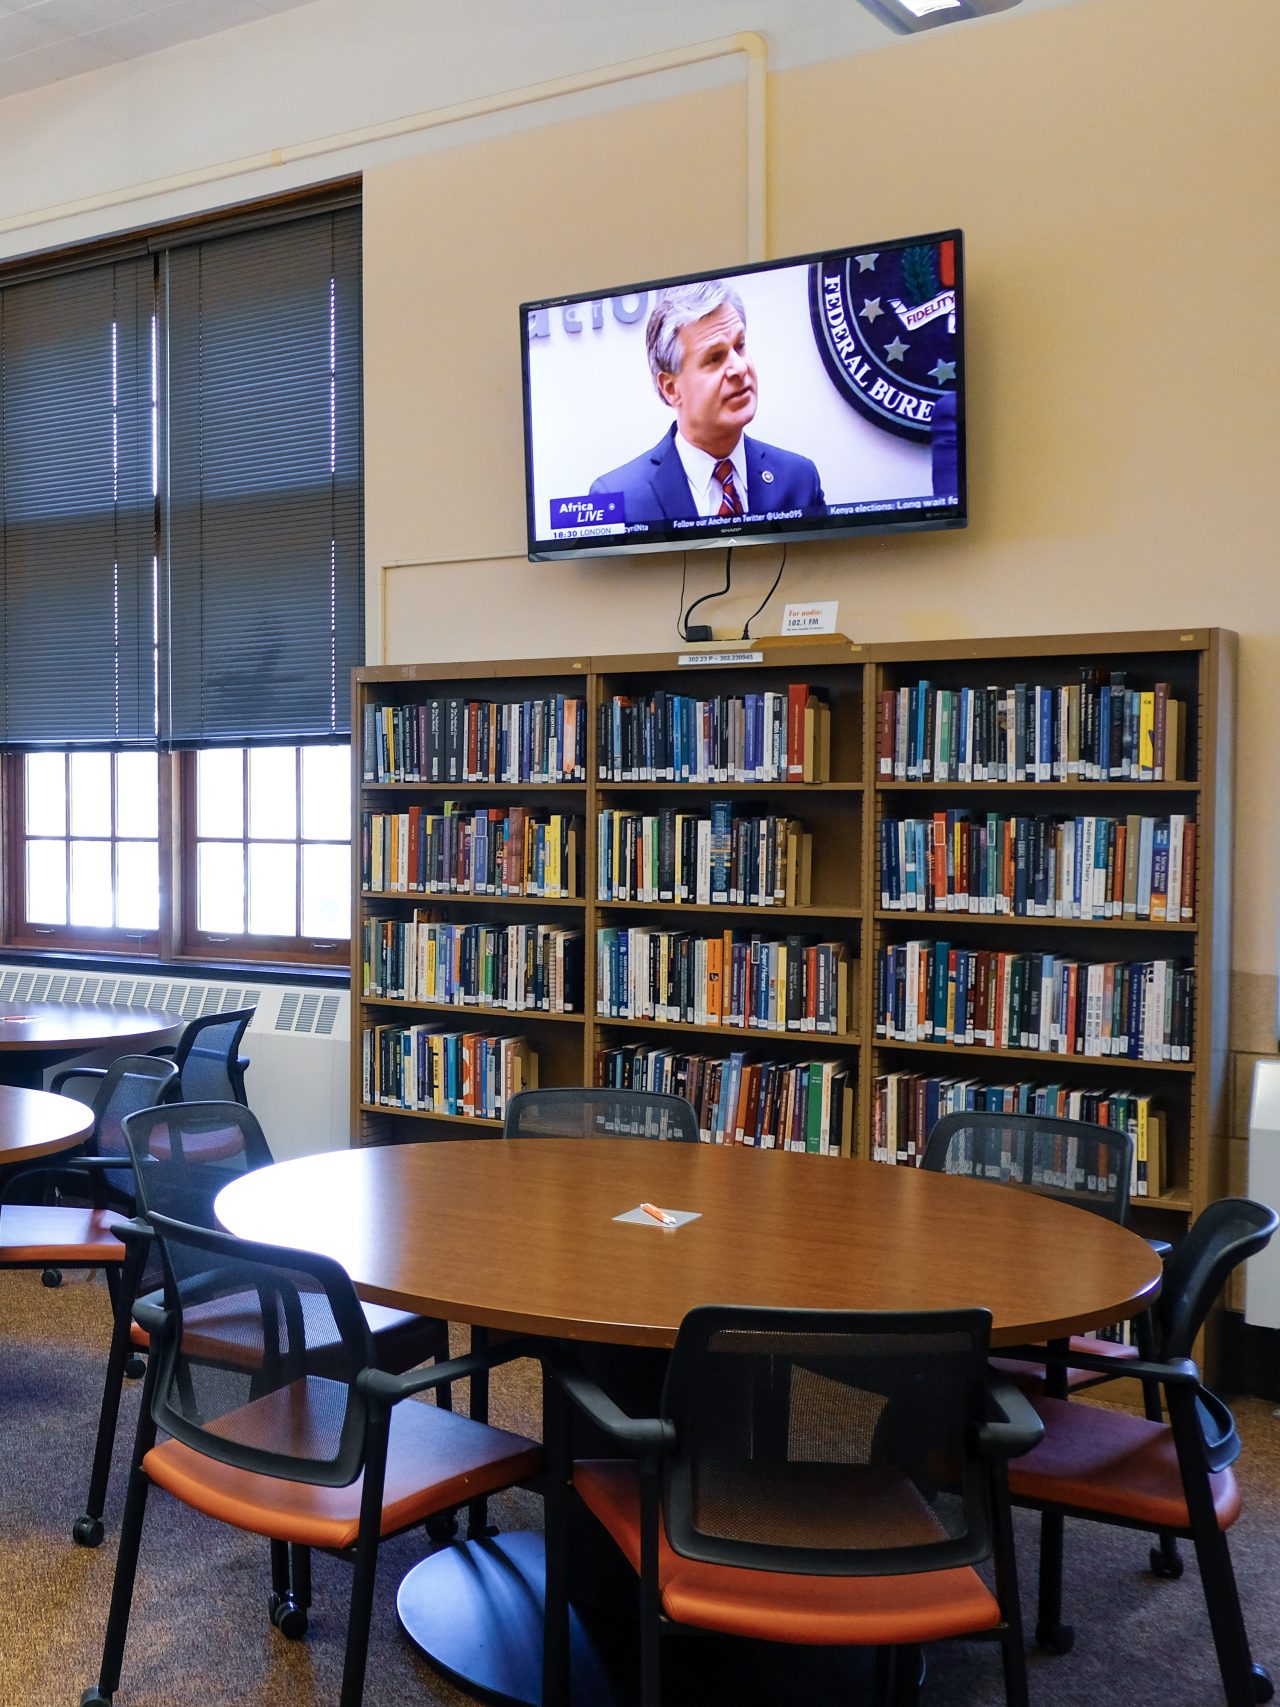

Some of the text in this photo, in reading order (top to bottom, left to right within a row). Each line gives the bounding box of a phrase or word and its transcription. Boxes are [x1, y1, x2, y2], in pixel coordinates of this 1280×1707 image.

[907, 295, 955, 325] FIDELITY
[824, 275, 935, 421] FEDERAL BURE
[559, 501, 593, 513] Africa
[830, 506, 854, 515] Kenya
[855, 503, 895, 513] elections:
[896, 500, 921, 509] Long
[922, 497, 946, 507] wait
[577, 509, 604, 522] LIVE
[673, 520, 695, 528] Follow
[708, 517, 731, 525] Anchor
[742, 514, 765, 522] Twitter
[552, 527, 611, 539] 18:30 LONDON
[788, 609, 823, 617] For audio:
